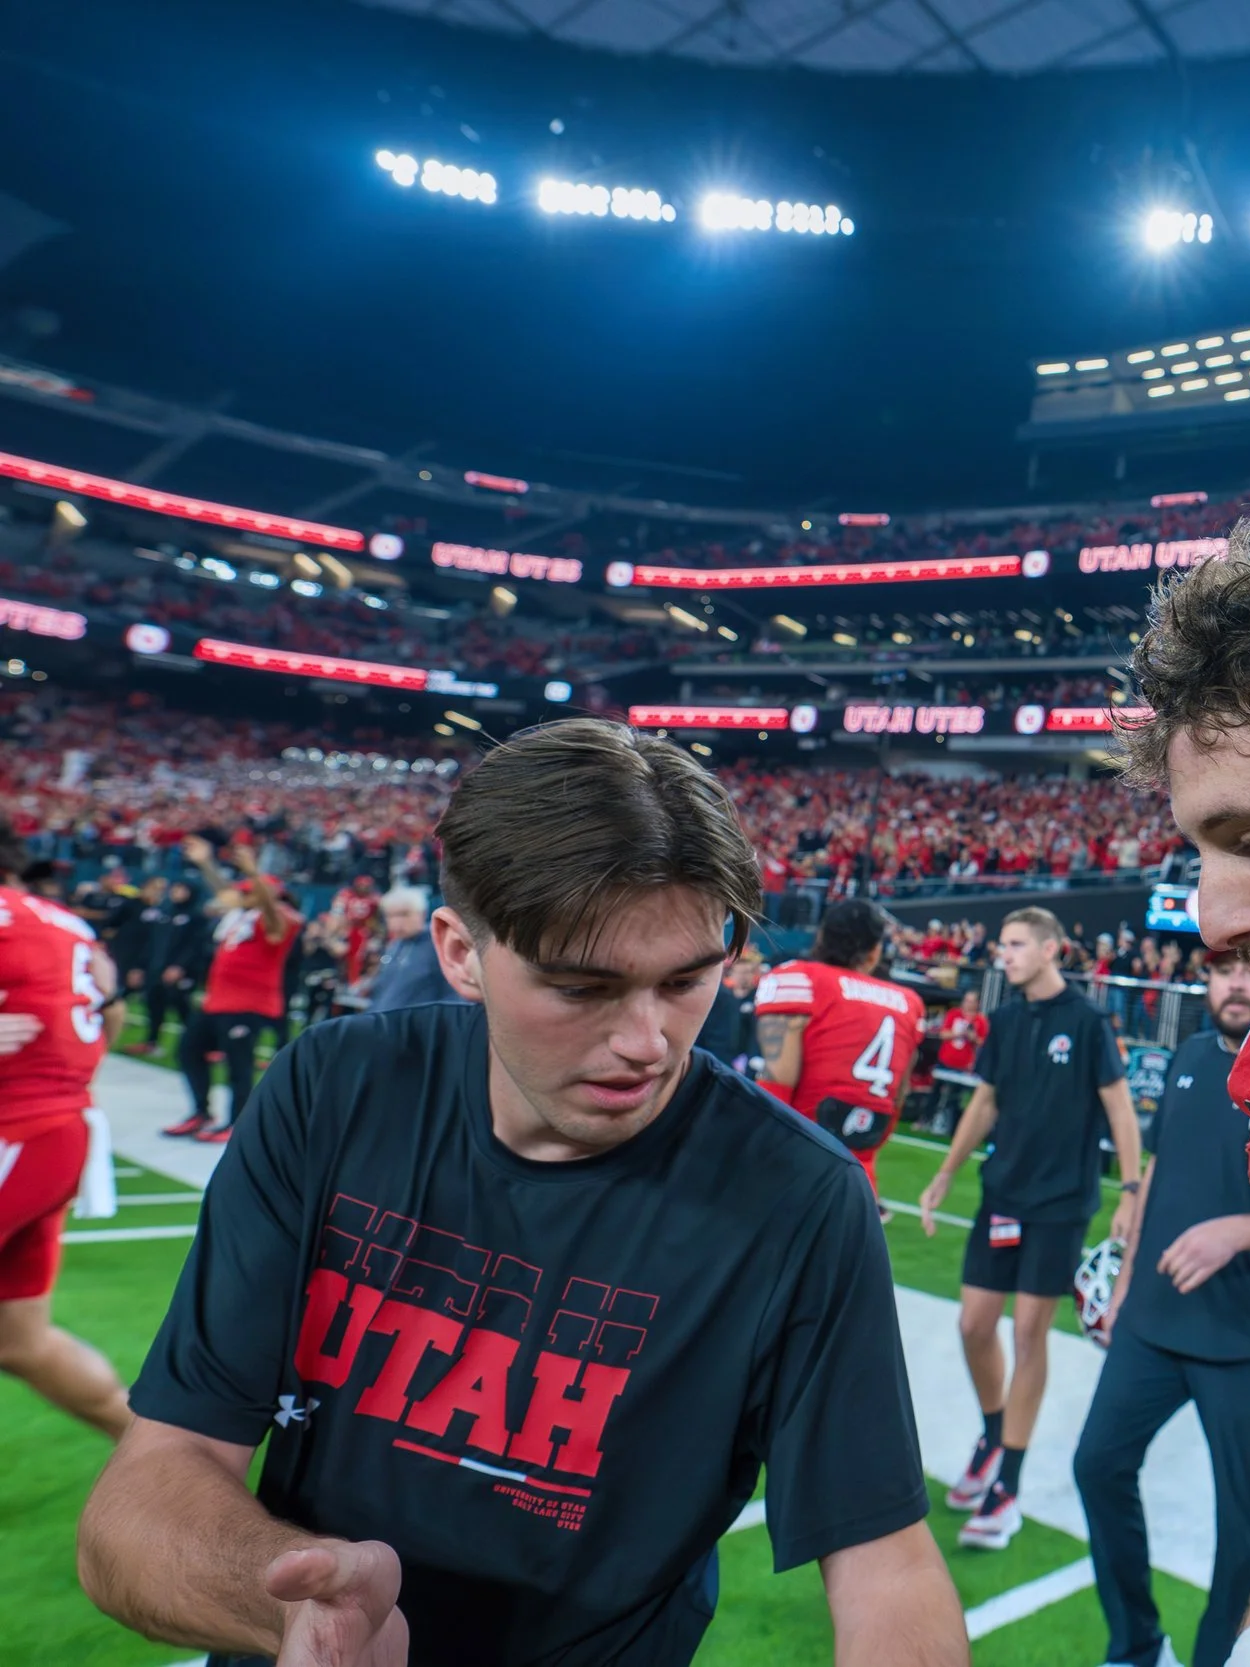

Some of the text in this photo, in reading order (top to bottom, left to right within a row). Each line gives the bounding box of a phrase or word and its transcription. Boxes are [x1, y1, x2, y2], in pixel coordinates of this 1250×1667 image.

[1079, 543, 1152, 573] UTAH
[843, 706, 985, 734] UTAH UTES
[852, 1015, 895, 1097] 4
[294, 1268, 631, 1478] UTAH
[493, 1484, 586, 1513] UNIVERSITY OF UTAH
[512, 1498, 584, 1522] SALT LAKE CITY
